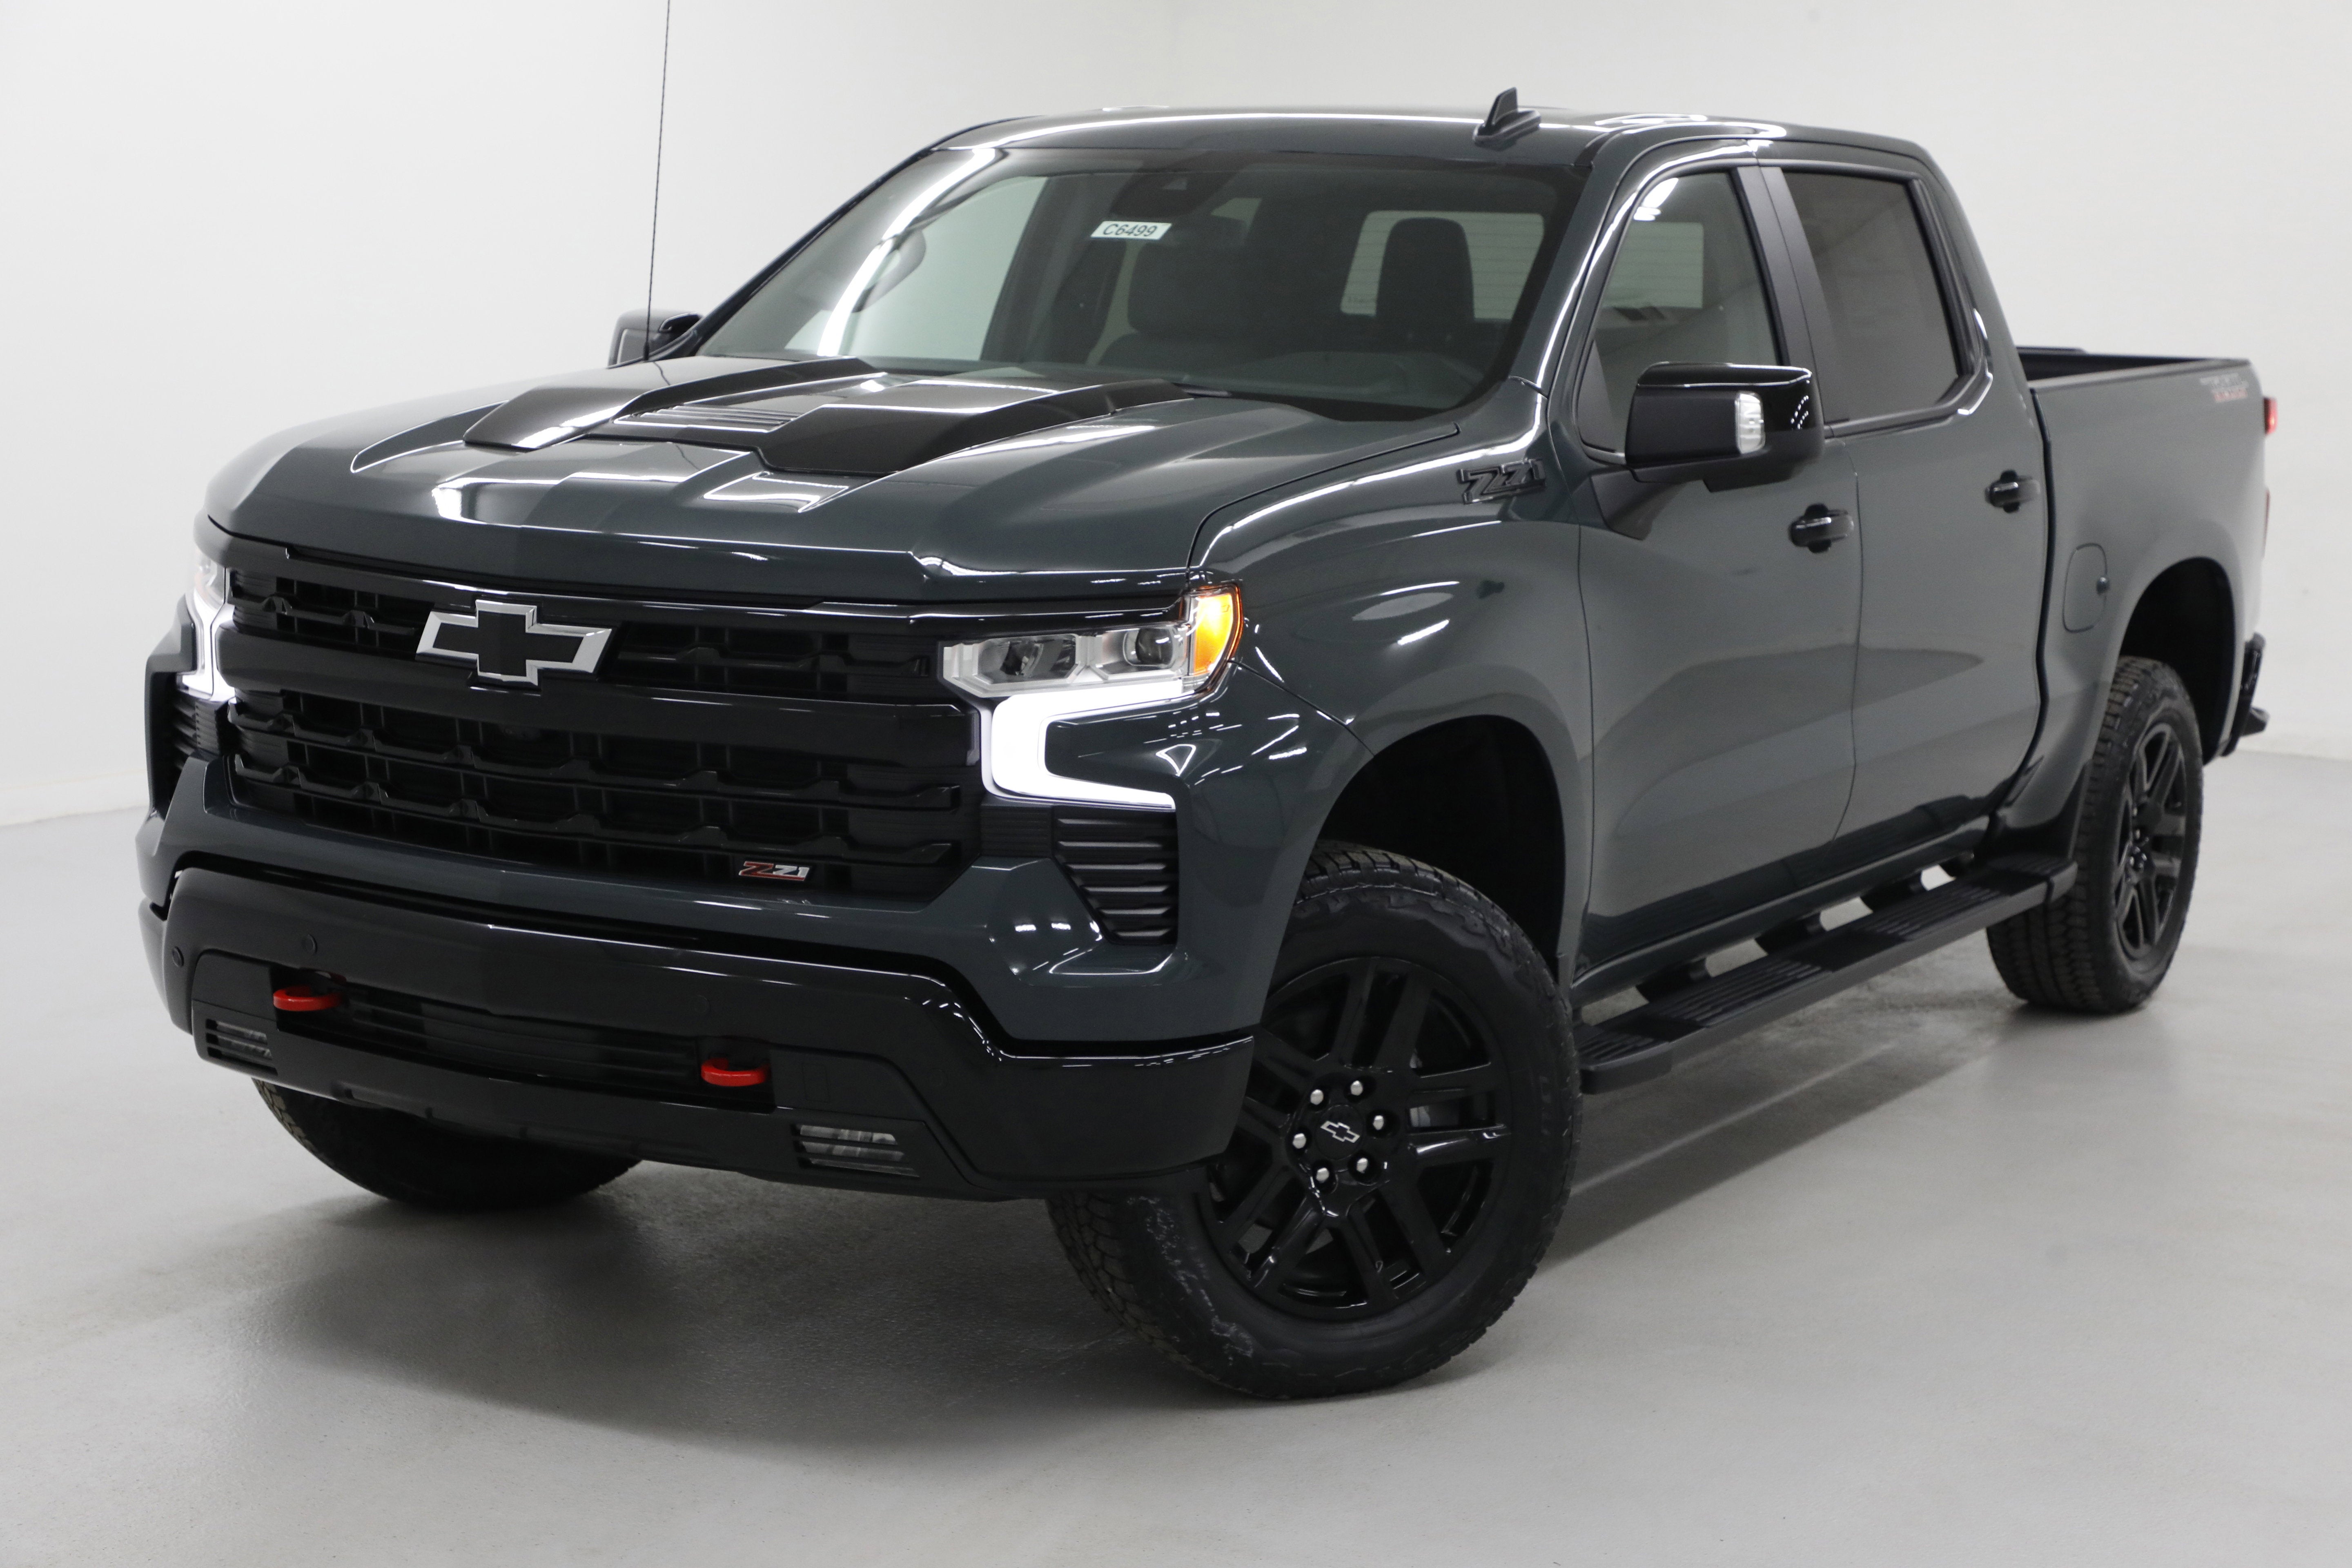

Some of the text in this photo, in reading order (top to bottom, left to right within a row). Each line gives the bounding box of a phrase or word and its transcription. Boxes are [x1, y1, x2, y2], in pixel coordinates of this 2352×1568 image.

[1103, 223, 1157, 236] C6499
[1456, 458, 1546, 505] Z71
[739, 861, 810, 881] Z71
